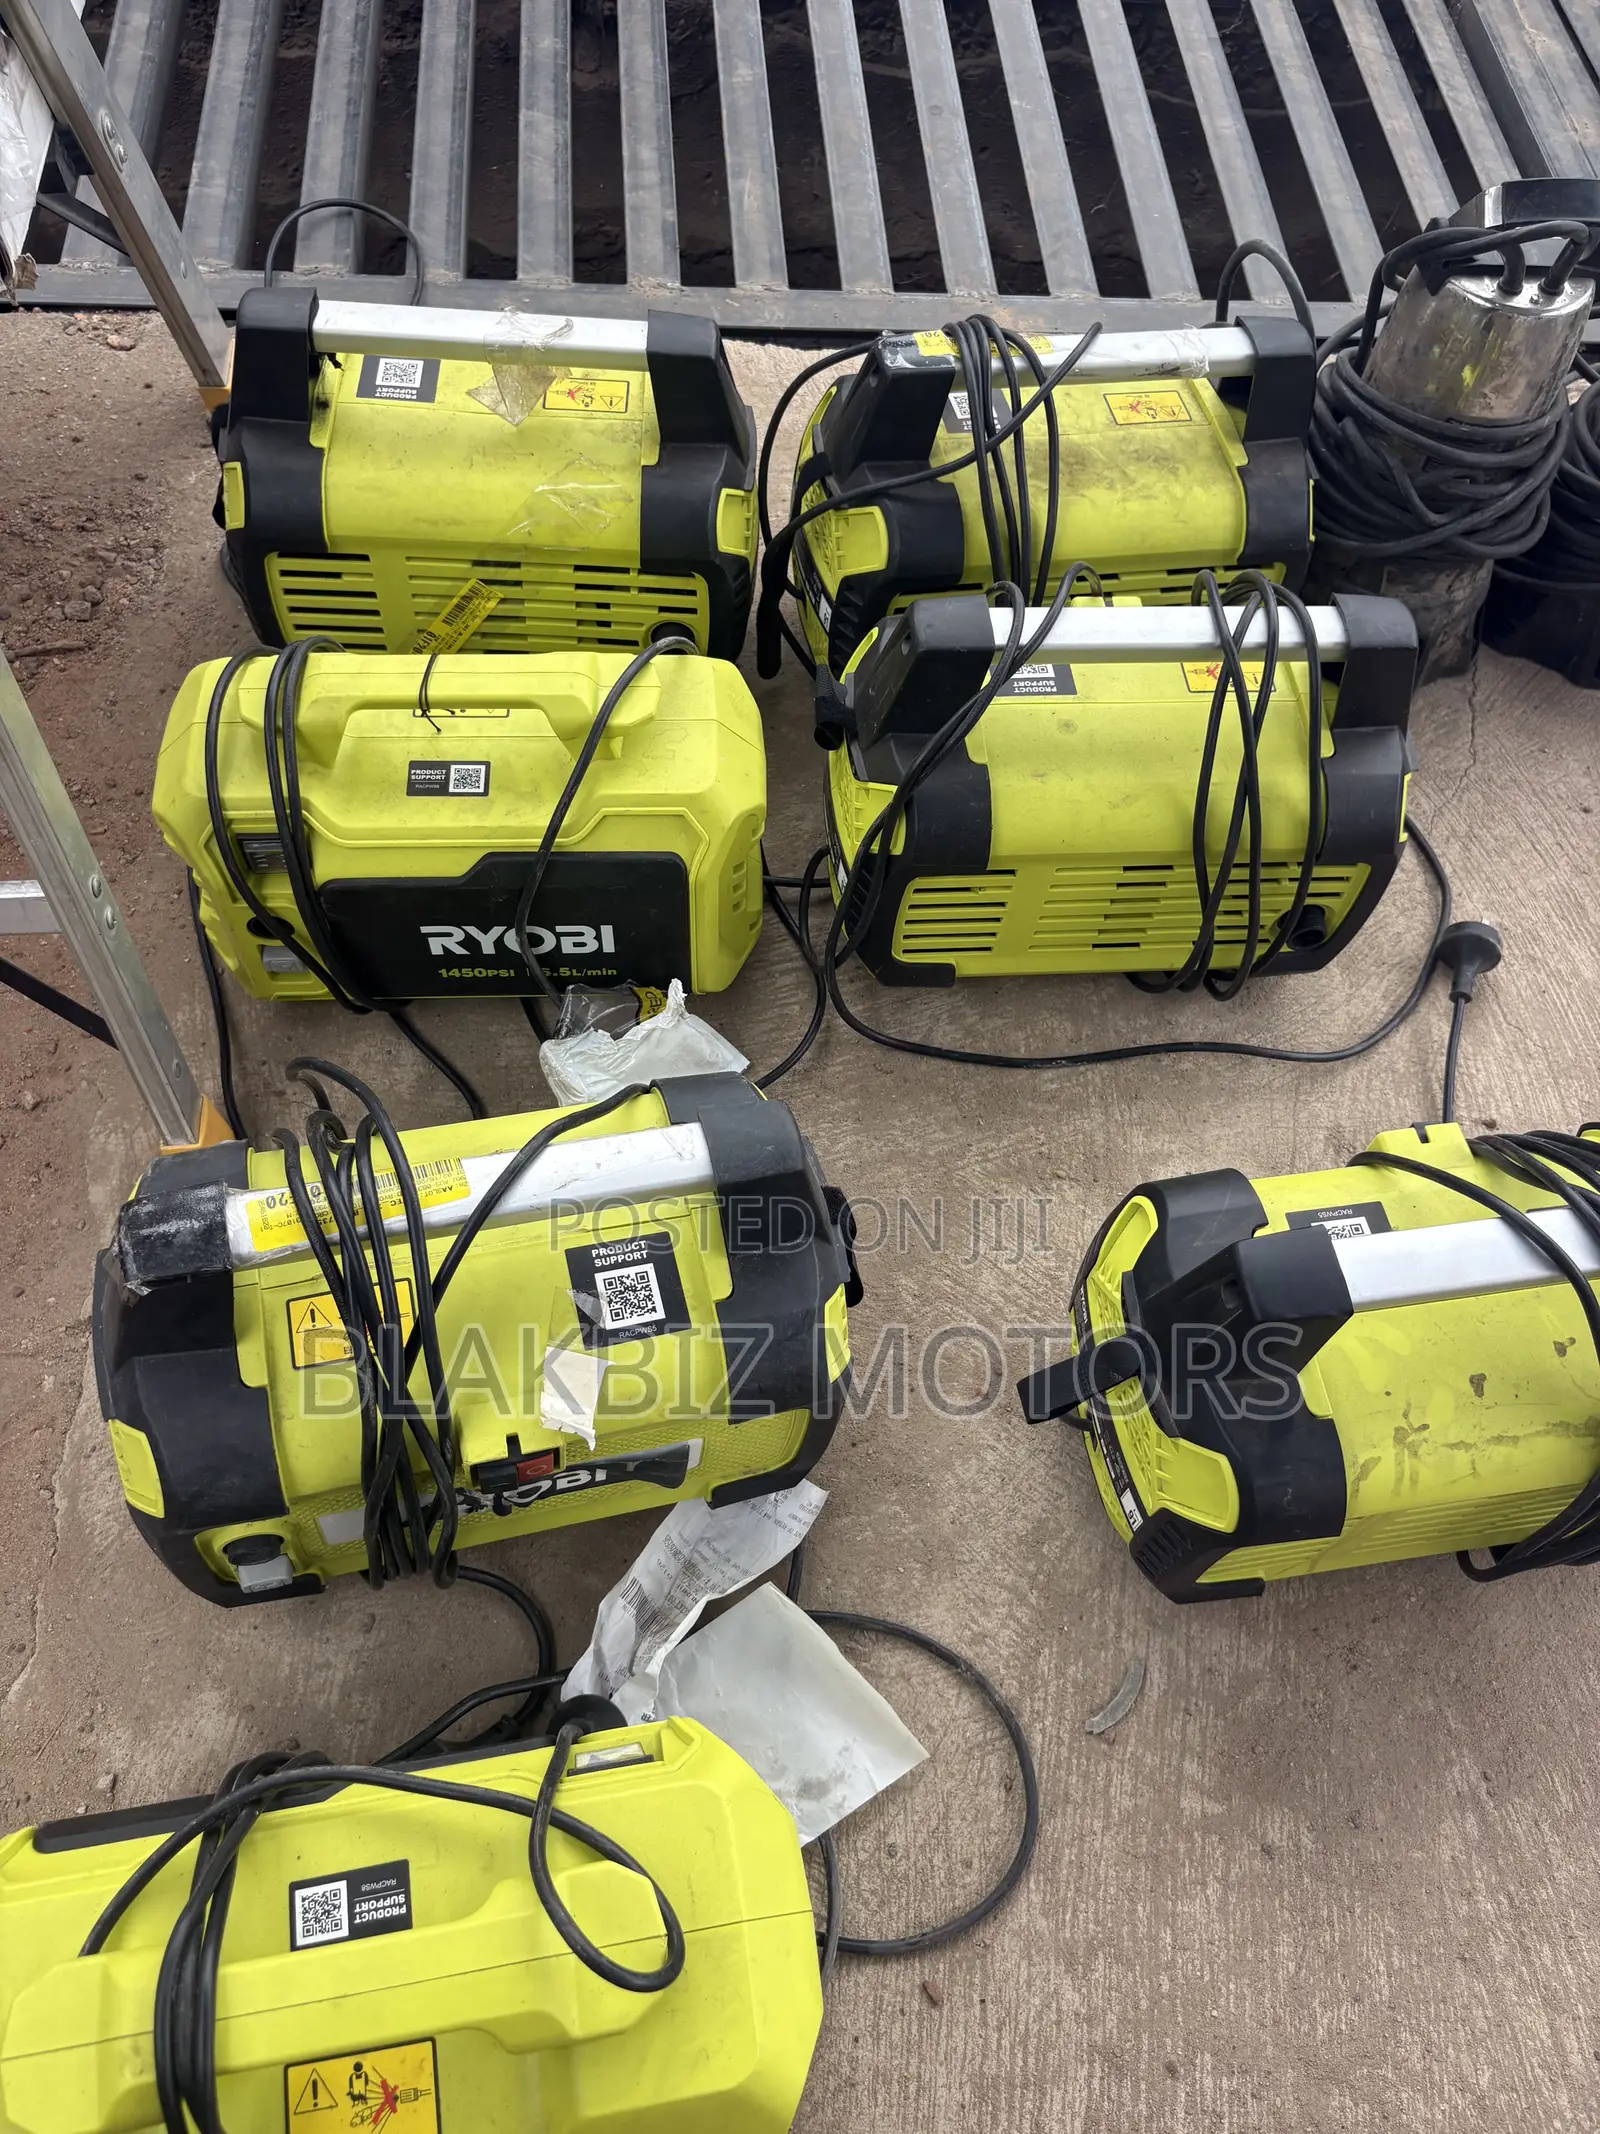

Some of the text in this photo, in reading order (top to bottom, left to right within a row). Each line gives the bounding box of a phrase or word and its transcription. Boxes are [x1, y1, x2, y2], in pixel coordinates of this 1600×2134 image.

[375, 392, 417, 400] PRODUCT
[376, 387, 417, 395] SUPPORT
[420, 925, 616, 955] RYOBI
[438, 967, 515, 978] 1450PSI
[1318, 1208, 1353, 1219] RACPWS5
[591, 1240, 647, 1258] PRODUCT
[594, 1250, 649, 1267] SUPPORT
[361, 1878, 397, 1891] RACPWS8
[353, 1893, 406, 1913] SUPPORT
[353, 1904, 407, 1924] PRODUCT
